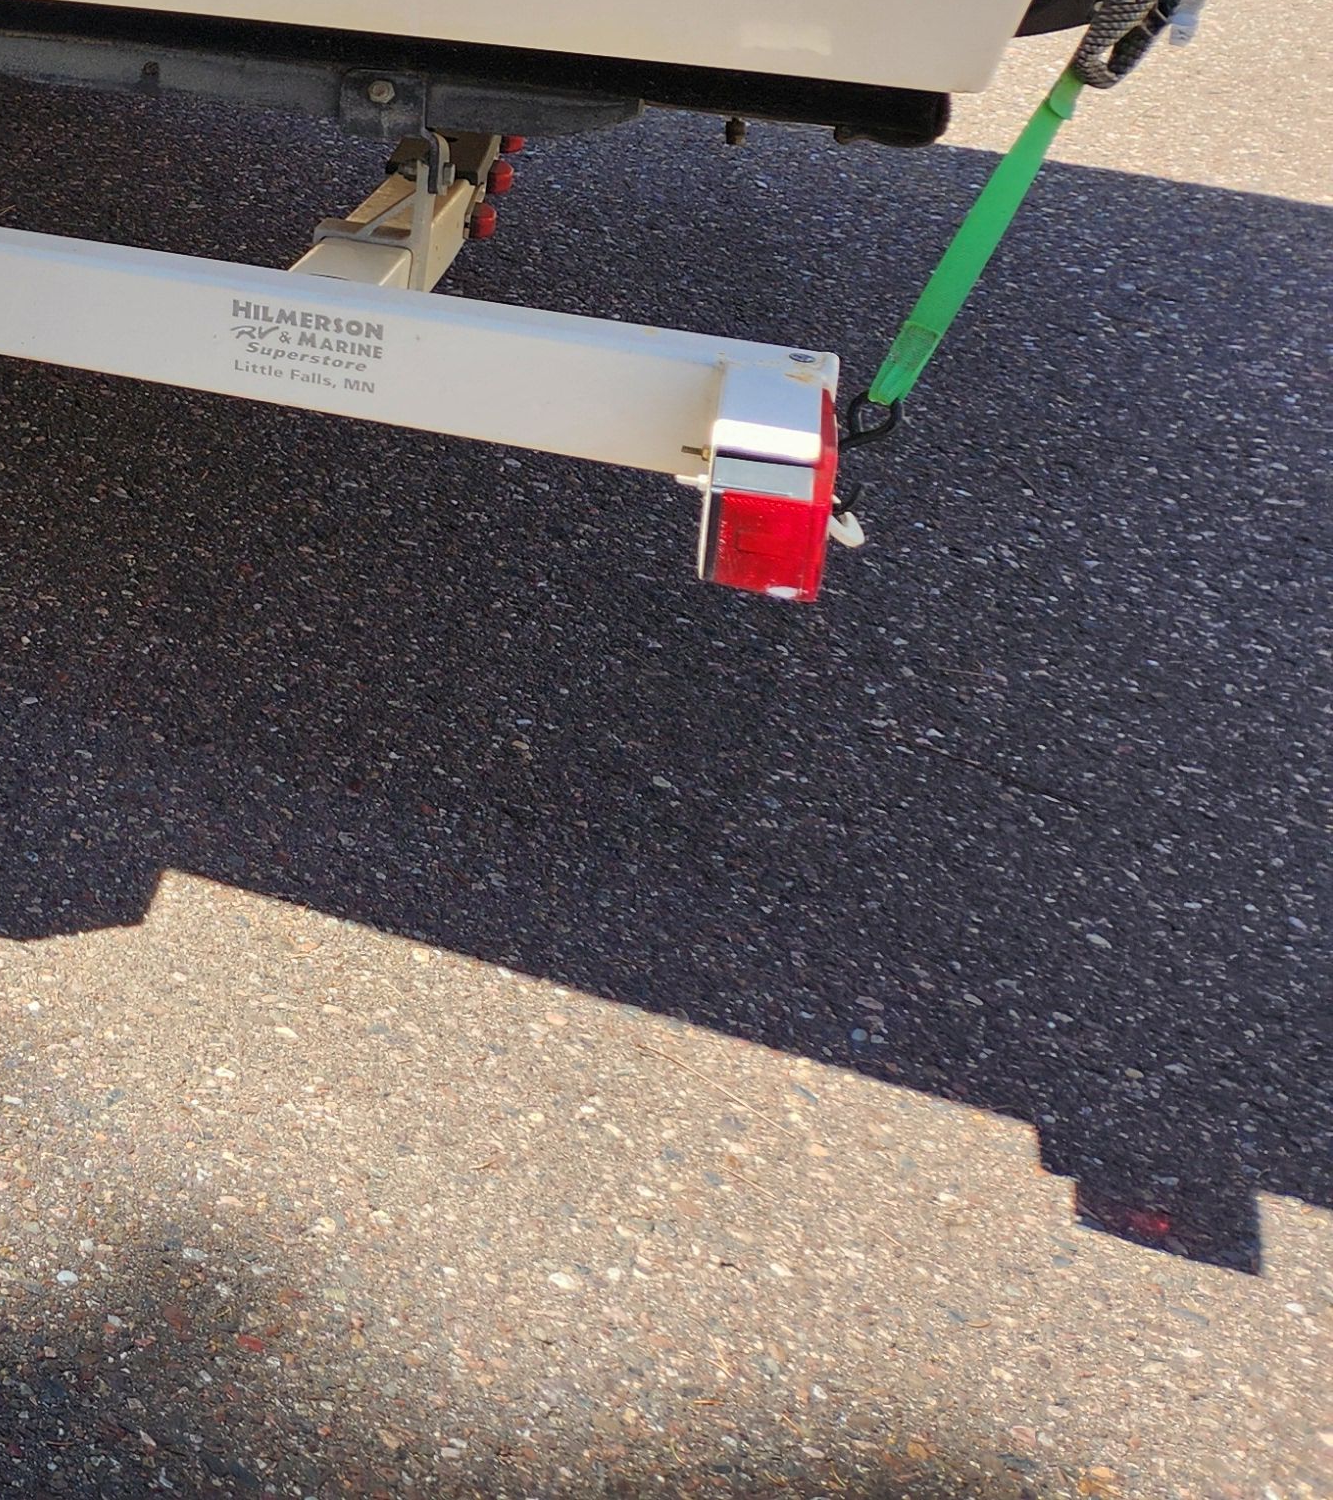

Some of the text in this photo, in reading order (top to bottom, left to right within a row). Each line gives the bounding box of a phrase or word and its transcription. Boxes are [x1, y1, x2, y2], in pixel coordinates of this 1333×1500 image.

[232, 299, 384, 340] HILMERSON
[230, 325, 383, 359] RV & MARINE
[246, 341, 367, 372] Superstore
[234, 359, 375, 393] Little Falls, MN
